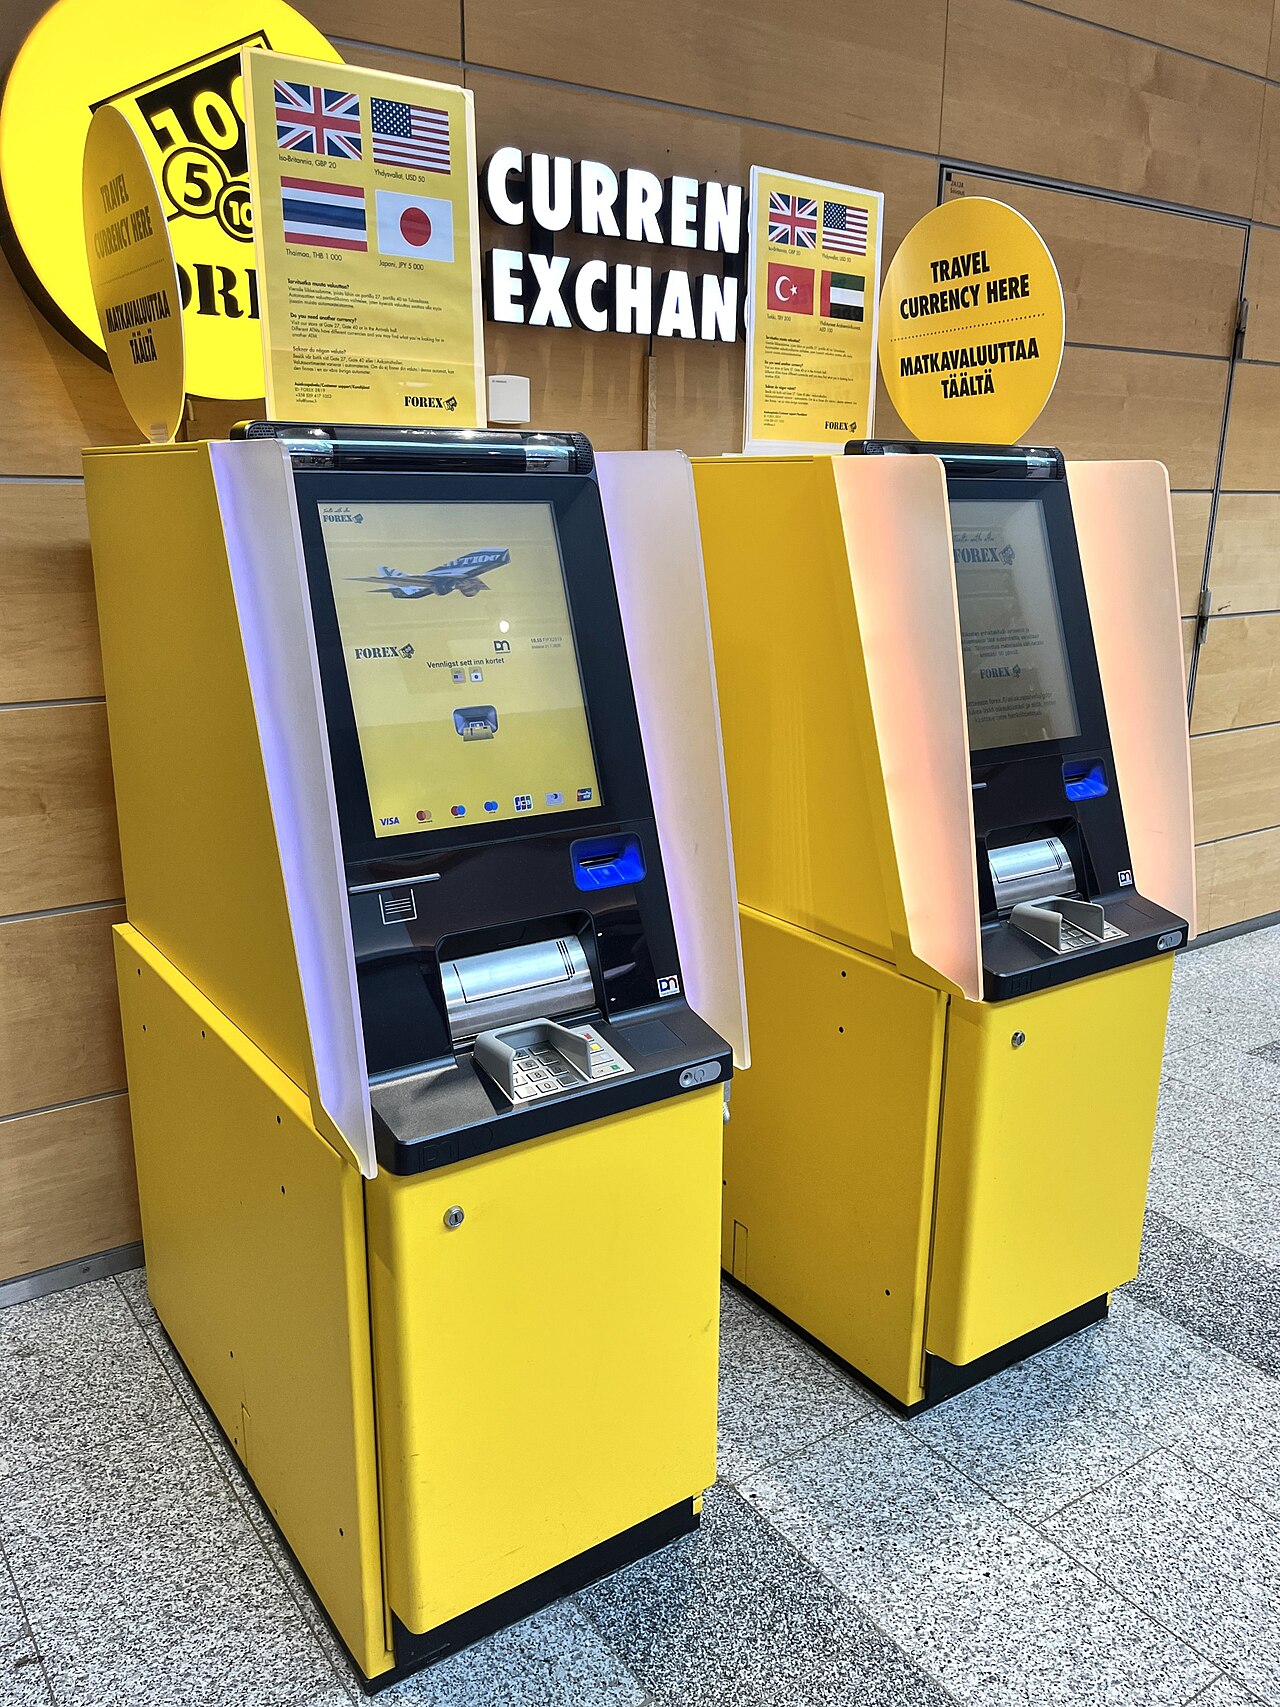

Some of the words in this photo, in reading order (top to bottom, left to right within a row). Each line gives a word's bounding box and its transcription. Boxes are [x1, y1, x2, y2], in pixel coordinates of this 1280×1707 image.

[279, 154, 313, 167] Iso-Britannia,
[184, 162, 212, 206] 5
[374, 168, 404, 180] Yhdysvallat,
[100, 174, 129, 214] TRAVEL
[487, 147, 750, 254] CURREN
[94, 217, 131, 259] CURRENCY
[130, 206, 153, 242] HERE
[286, 248, 312, 259] Thaimaa,
[313, 251, 323, 259] THB
[379, 260, 397, 269] Japani,
[930, 250, 990, 283] TRAVEL
[492, 248, 749, 342] EXCHAN
[900, 284, 980, 320] CURRENCY
[986, 274, 1030, 304] HERE
[106, 290, 171, 333] MATKAVALUUTTAA
[336, 316, 357, 324] currency?
[129, 329, 158, 364] TÄÄLTÄ
[900, 338, 1039, 377] MATKAVALUUTTAA
[941, 369, 994, 398] TÄÄLTÄ
[404, 396, 444, 409] FOREX
[825, 421, 848, 430] FOREX
[954, 548, 1000, 563] FOREX
[355, 646, 399, 659] FOREX
[980, 666, 1010, 679] FOREX
[380, 817, 400, 826] VISA
